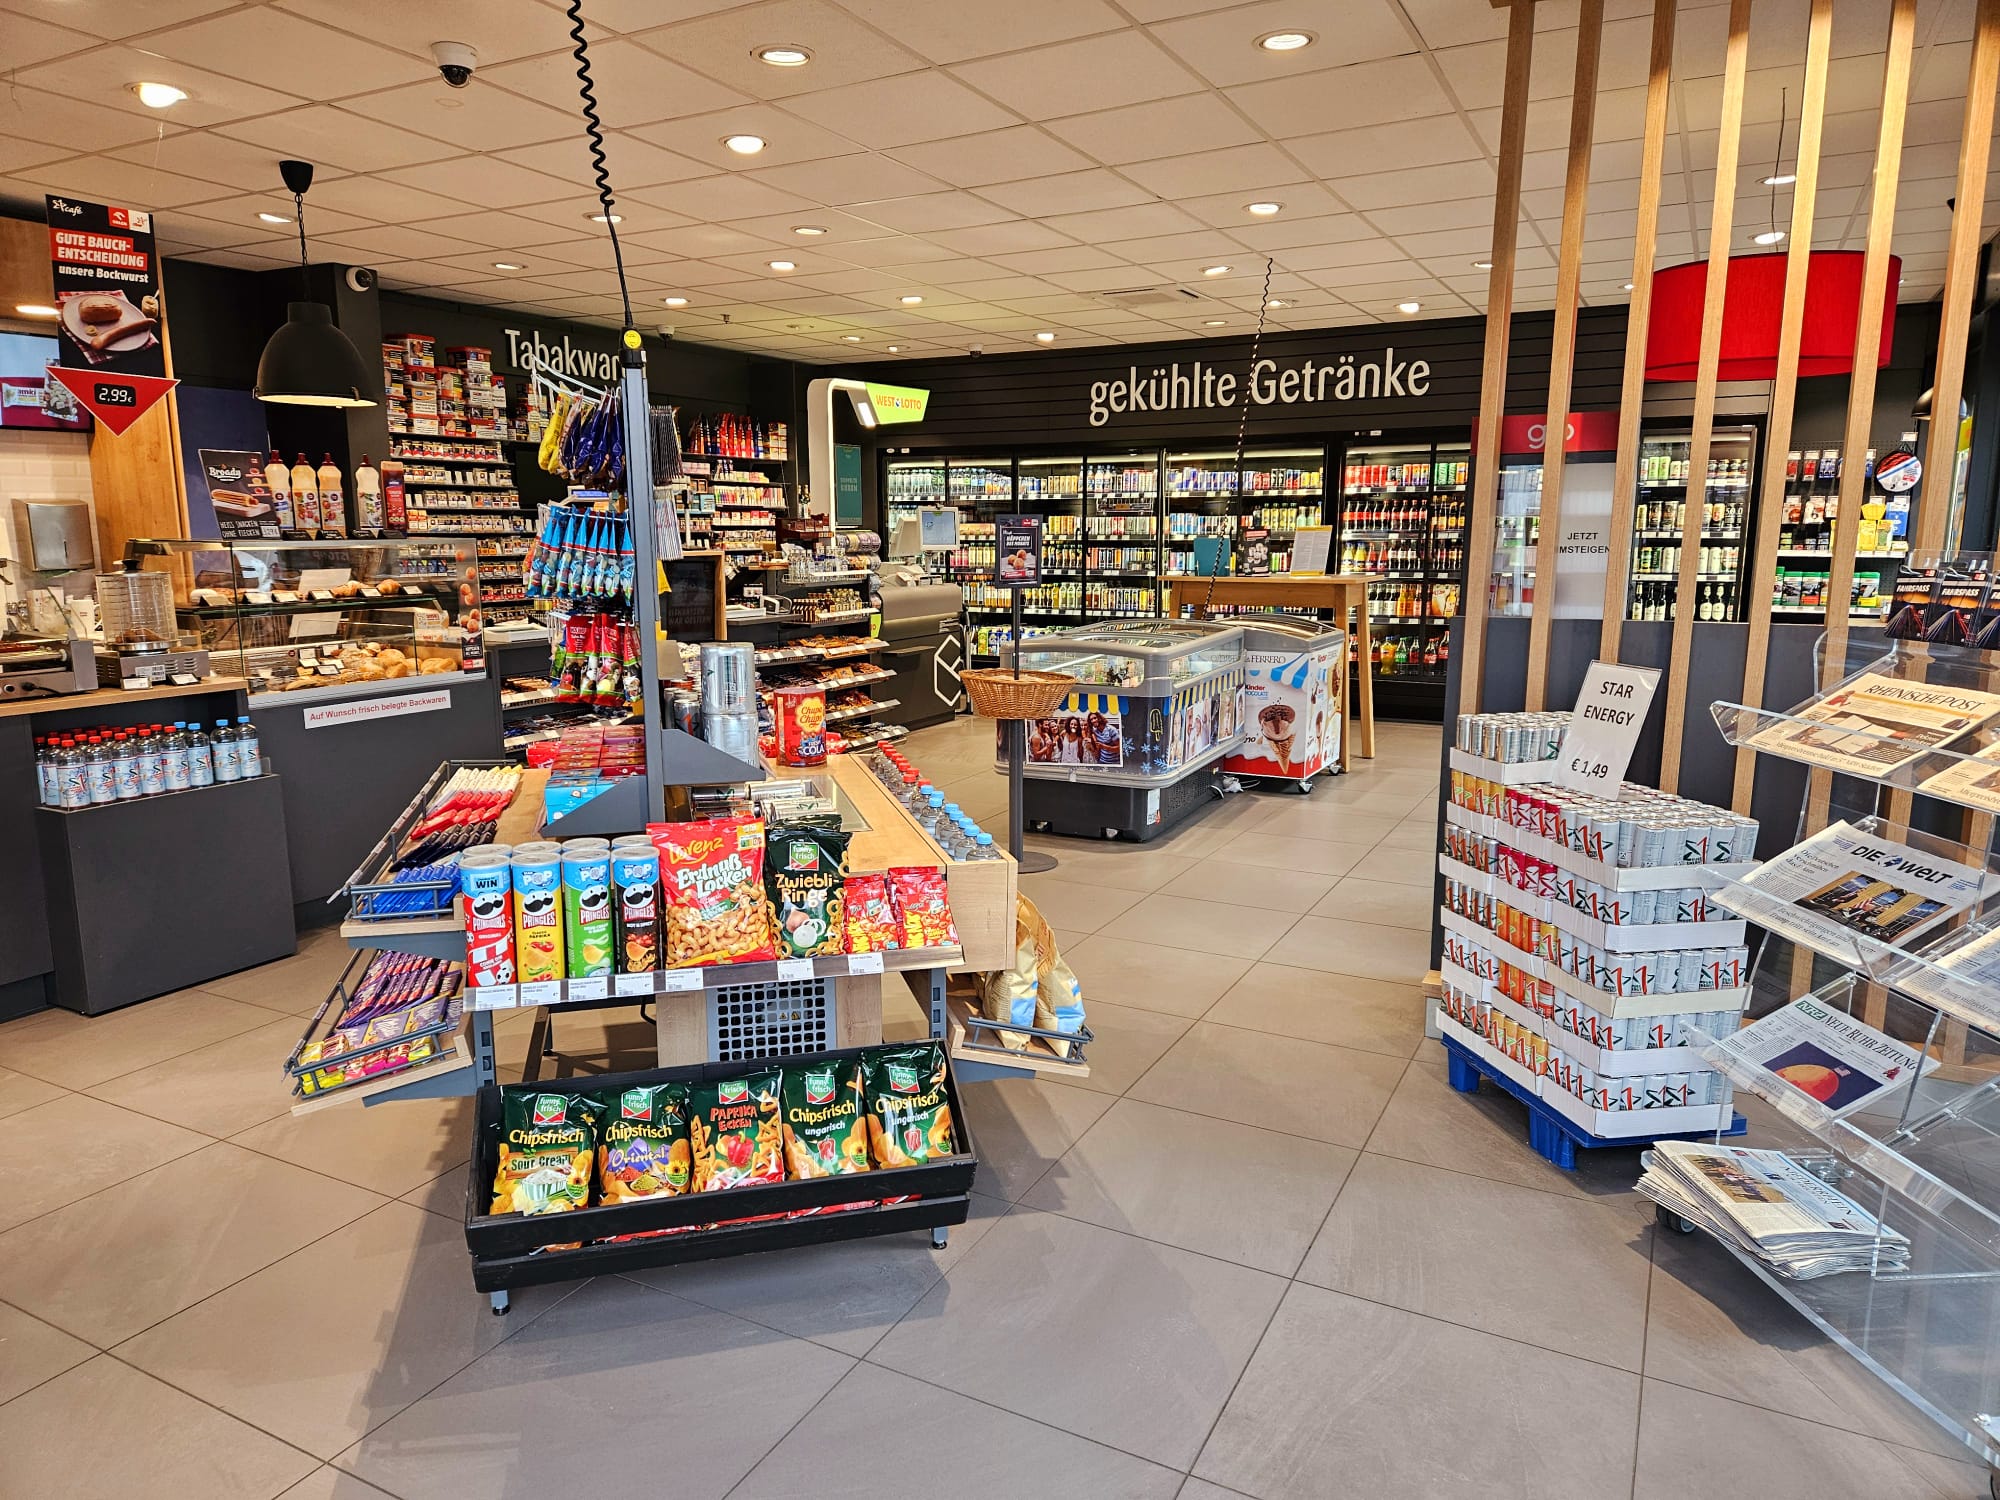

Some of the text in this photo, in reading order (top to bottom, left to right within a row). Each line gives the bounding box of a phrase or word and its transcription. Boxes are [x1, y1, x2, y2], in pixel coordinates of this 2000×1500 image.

[56, 232, 131, 251] GUTE BAUCH-
[57, 247, 144, 267] ENTSCHEIDUNG
[59, 265, 149, 283] unsere Bockwurst
[1089, 348, 1431, 427] gekühlte Getränke
[901, 397, 922, 410] LOTTO
[1568, 532, 1598, 540] JETZT
[1896, 585, 1931, 593] FAHRSPASS
[1942, 588, 1980, 597] FAHRSPASS
[1251, 655, 1287, 664] FERRERO
[1600, 681, 1634, 699] STAR
[1865, 684, 1986, 712] RHEINISCHE POST
[310, 696, 446, 721] Auf Wunsch frisch belegte Backwaren
[1584, 705, 1635, 727] ENERGY
[803, 745, 825, 756] COLA
[1571, 758, 1608, 778] € 1,49
[1850, 845, 1886, 862] DIE
[523, 870, 553, 886] POP
[580, 864, 607, 881] POP
[624, 863, 652, 879] POP
[676, 853, 743, 890] Erdnuß
[476, 879, 498, 888] WIN
[696, 866, 752, 898] Locken
[775, 872, 840, 889] Zwiebli-
[781, 888, 828, 908] Ringe
[523, 911, 556, 929] PRINGLES
[580, 905, 610, 924] PRINGLES
[624, 902, 655, 920] PRINGLES
[1798, 1001, 1828, 1019] NRZ
[1823, 1015, 1919, 1071] NEUE RUHR ZEITUNG
[725, 1086, 744, 1094] frisch
[540, 1104, 562, 1113] frisch
[627, 1100, 648, 1109] frisch
[875, 1092, 939, 1114] Chipsfrisch
[709, 1105, 758, 1122] PAPRIKA
[789, 1100, 856, 1125] Chipsfrisch
[605, 1124, 673, 1143] Chipsfrisch
[718, 1119, 752, 1132] ECKEN
[805, 1120, 846, 1137] ungarisch
[509, 1128, 585, 1147] Chipsfrisch
[511, 1158, 535, 1171] Sour
[611, 1149, 666, 1167] Oriental
